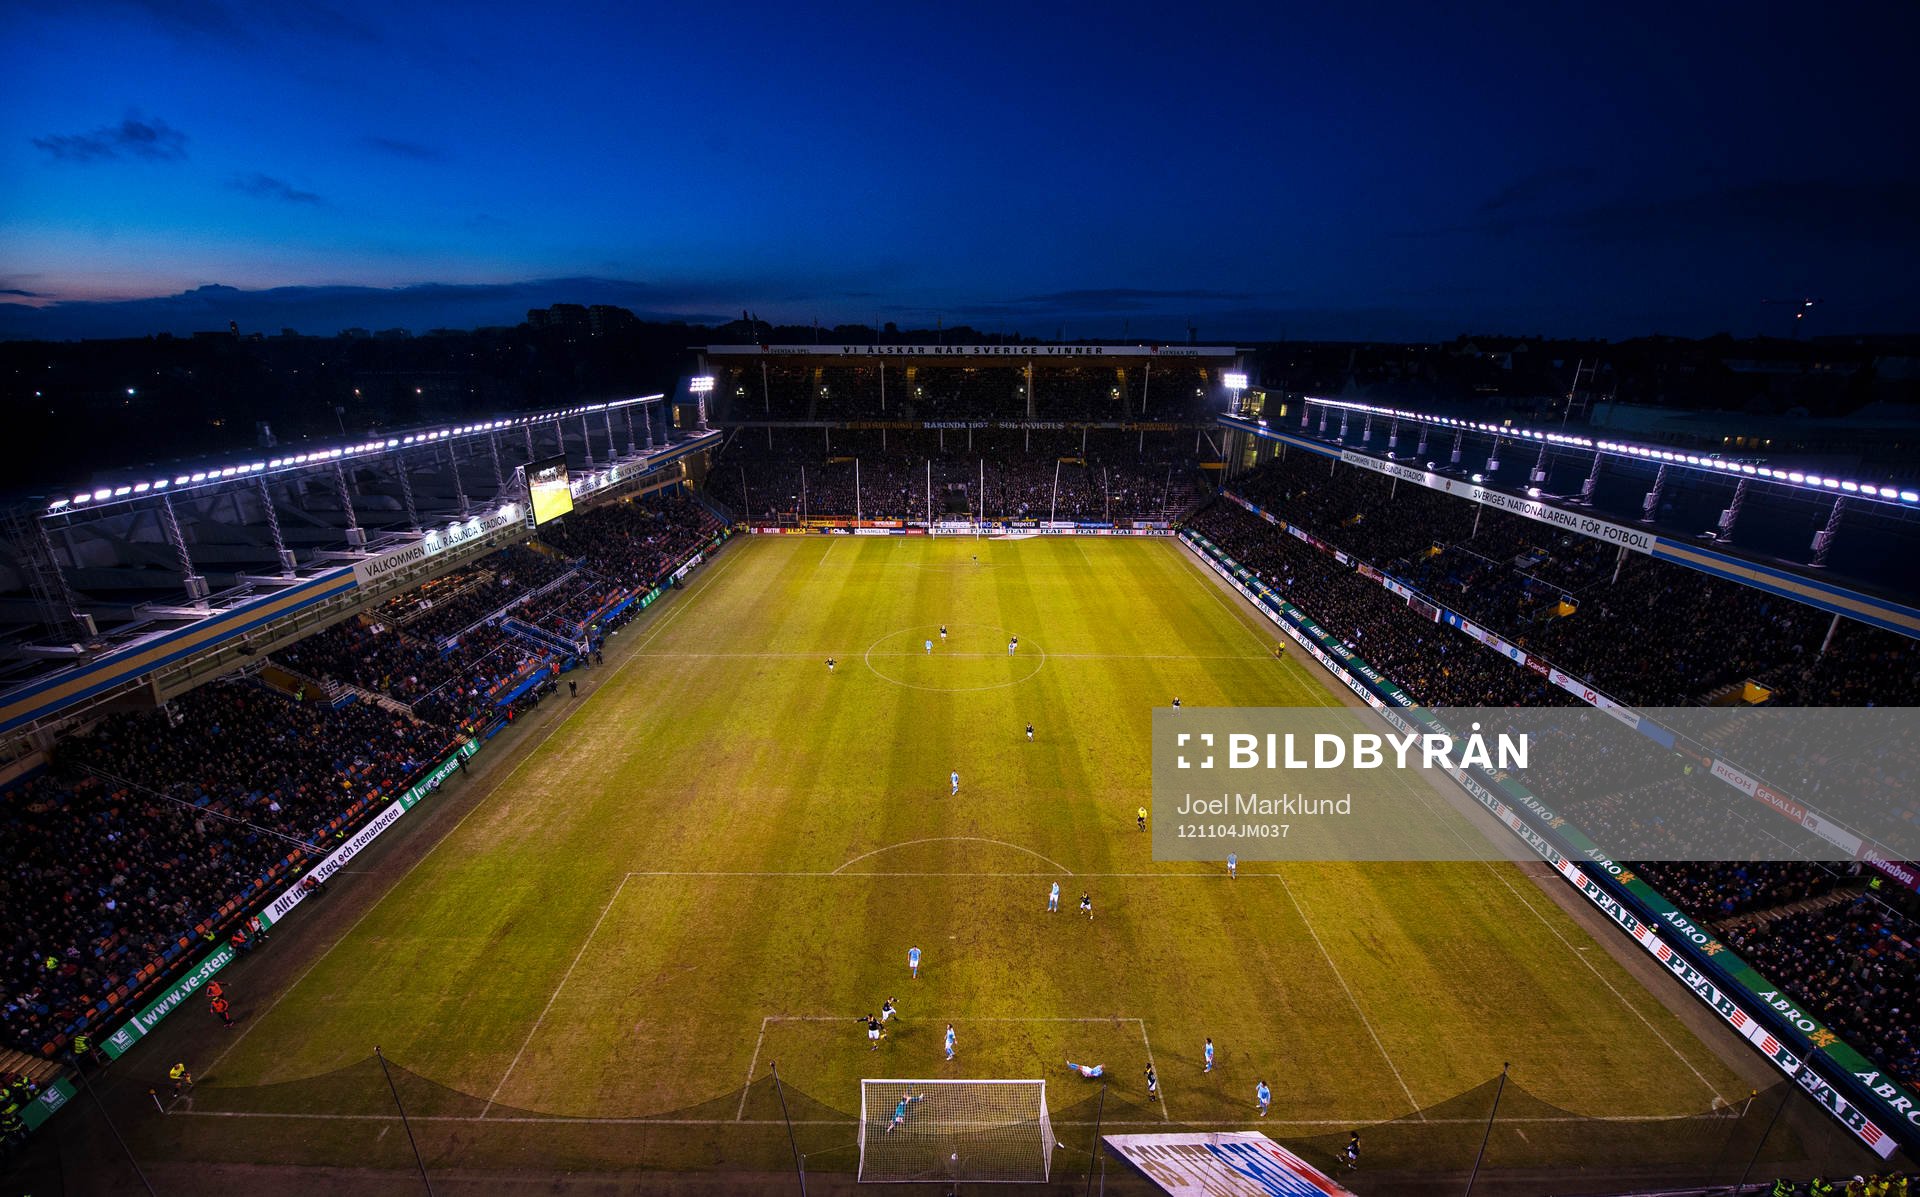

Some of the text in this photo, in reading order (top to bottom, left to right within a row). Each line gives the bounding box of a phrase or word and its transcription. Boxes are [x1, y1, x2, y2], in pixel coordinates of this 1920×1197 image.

[843, 346, 857, 354] VI
[973, 346, 1038, 354] SVERIGE
[1047, 346, 1103, 354] VINNER
[1343, 451, 1370, 466] VÄLKOMMEN
[1370, 458, 1379, 469] TILL
[1403, 469, 1426, 483] STADION
[1473, 489, 1648, 549] SVERIGES NATIONALARENA FÖR FOTBOLL
[365, 546, 425, 577] VÄLKOMMEN
[427, 538, 440, 555] TILL
[480, 514, 507, 533] STADION
[1277, 616, 1291, 632] PEAB
[1298, 634, 1315, 652] PEAB
[1321, 655, 1341, 675] PEAB
[1526, 658, 1549, 677] Scandic
[1349, 679, 1371, 700] PEAB
[1390, 688, 1412, 707] ÅBRO
[1583, 689, 1598, 705] ICA
[1380, 707, 1406, 732] PEAB
[1463, 776, 1500, 811] PEAB
[1716, 765, 1752, 790] RICOH
[1520, 795, 1553, 821] ÅBRO
[1757, 788, 1802, 820] GEVALIA
[1517, 821, 1561, 865] PEAB
[273, 894, 294, 916] Allt
[353, 808, 399, 849] stenarbeten
[1585, 847, 1622, 875] ÅBRO
[1863, 849, 1914, 885] Marabou
[1583, 880, 1639, 932] PEAB
[1662, 910, 1707, 944] ÅBRO
[1665, 950, 1737, 1018] PEAB
[1758, 990, 1815, 1032] ÅBRO
[1773, 1045, 1867, 1133] PEAB
[1853, 1071, 1920, 1126] ÅBRO
